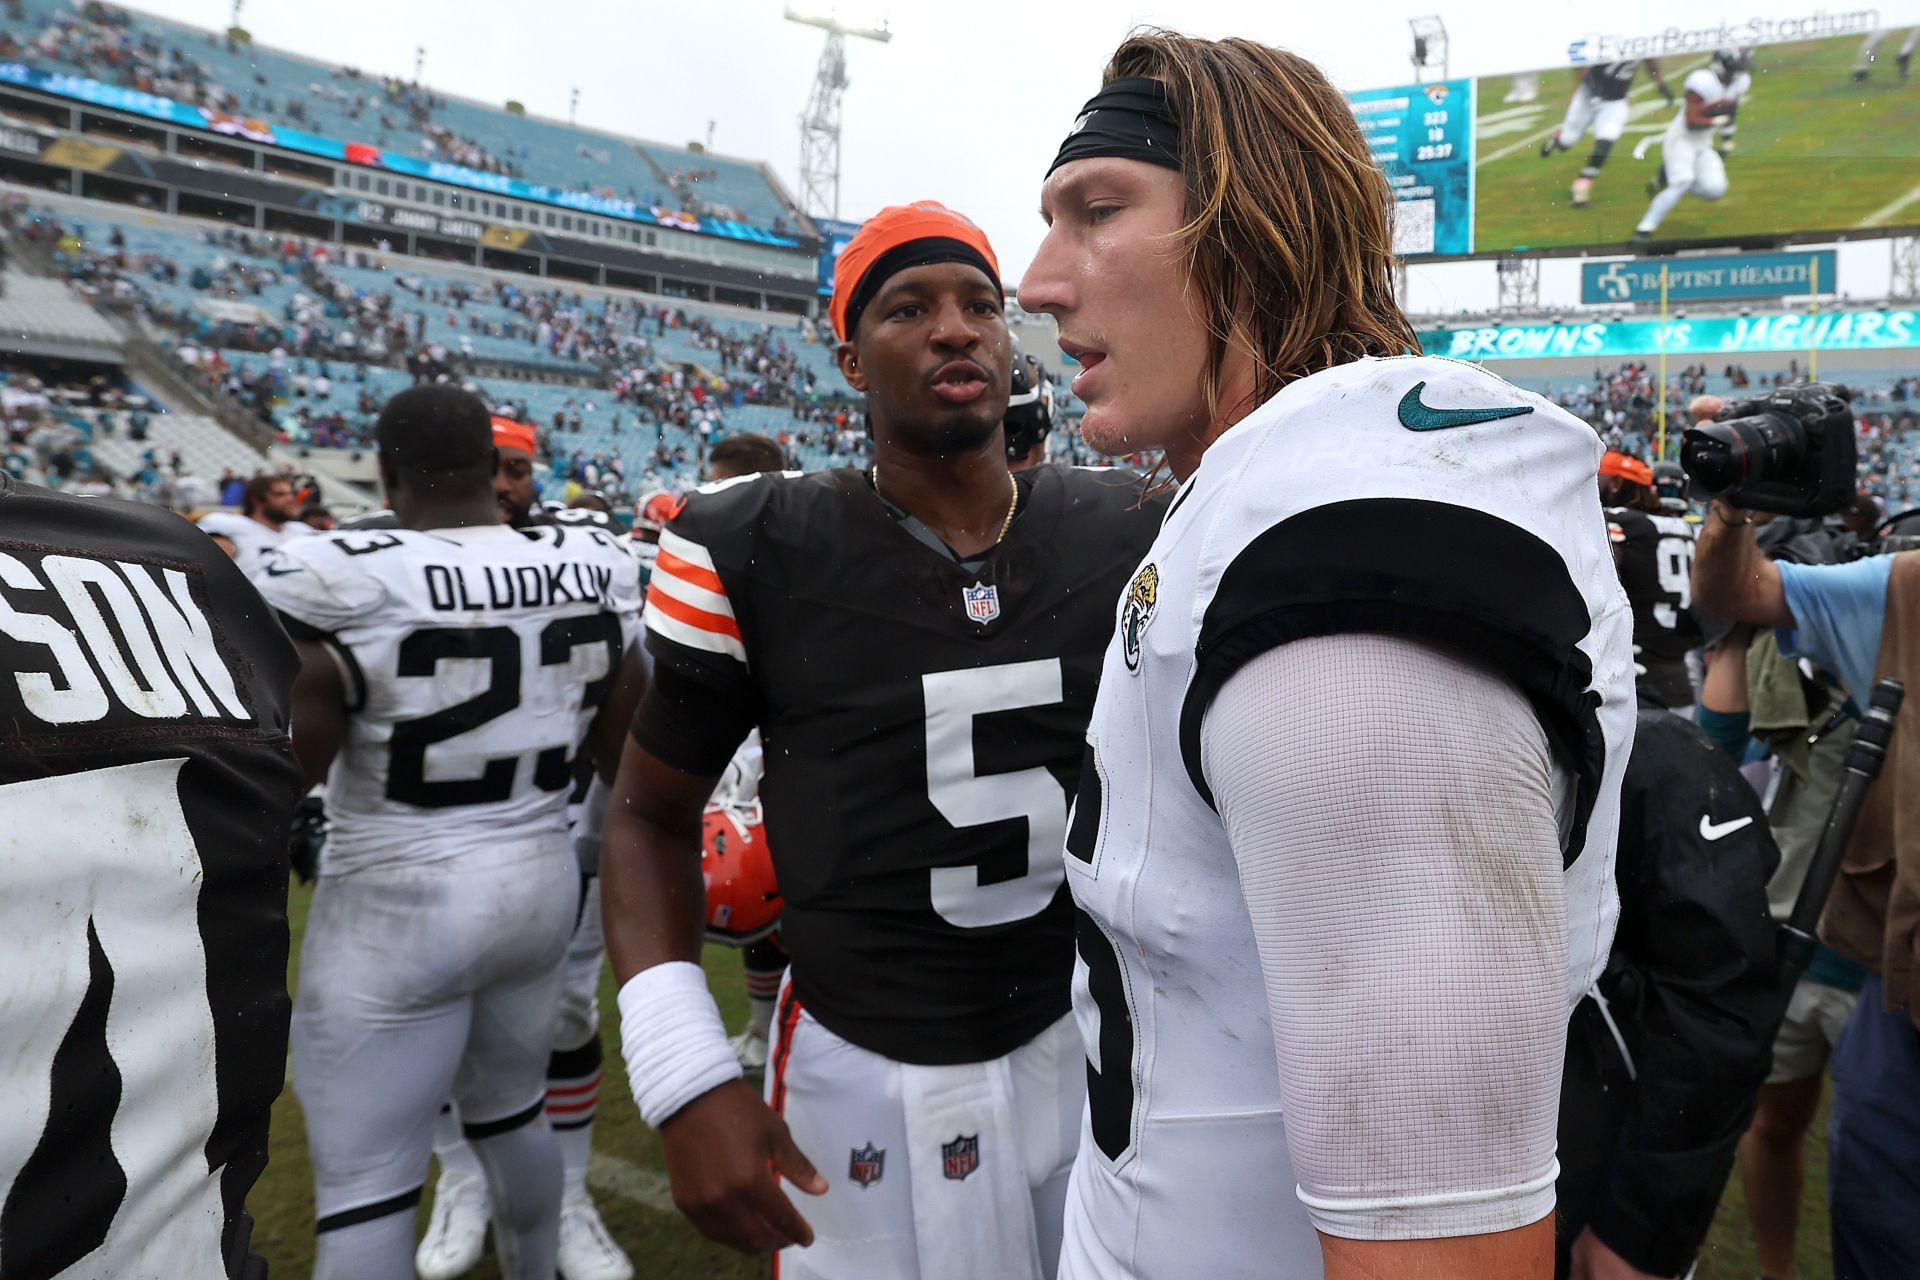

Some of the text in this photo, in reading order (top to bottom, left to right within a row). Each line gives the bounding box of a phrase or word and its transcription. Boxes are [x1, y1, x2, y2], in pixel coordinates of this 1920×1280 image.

[1599, 8, 1880, 60] EverBank Stadium
[1448, 322, 1603, 357] BROWNS
[1720, 311, 1916, 350] JAGUARS
[971, 600, 994, 616] NFL
[386, 609, 625, 807] 23
[921, 657, 1068, 929] 5
[946, 1152, 977, 1176] NFL
